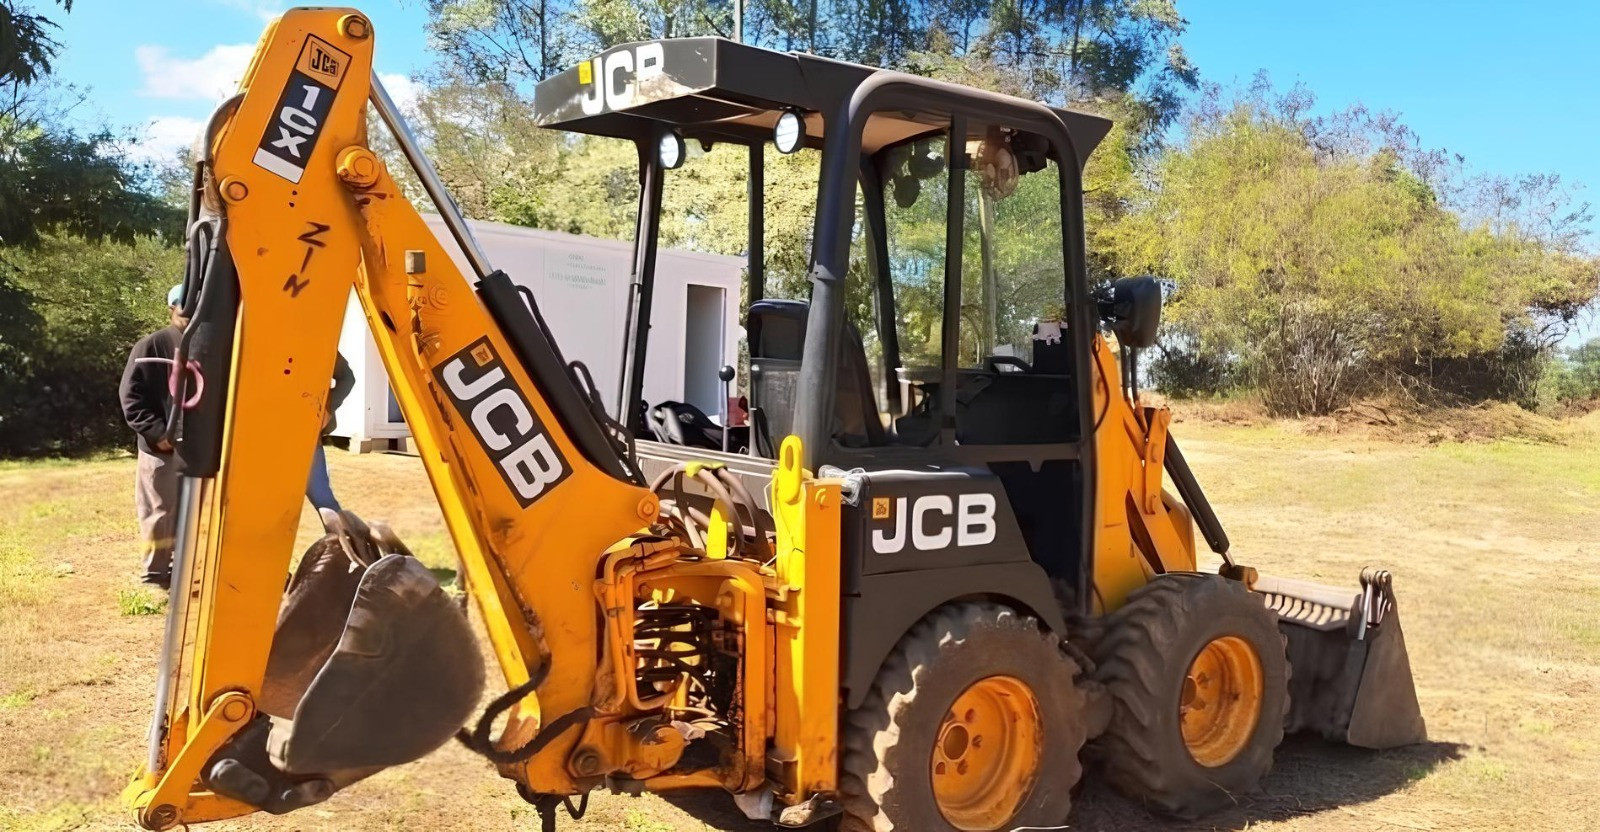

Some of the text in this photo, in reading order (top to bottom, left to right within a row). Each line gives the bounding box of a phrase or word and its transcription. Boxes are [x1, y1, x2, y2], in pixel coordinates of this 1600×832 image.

[271, 85, 318, 158] 1CX
[443, 357, 563, 499] JCB
[872, 493, 997, 554] JCB
